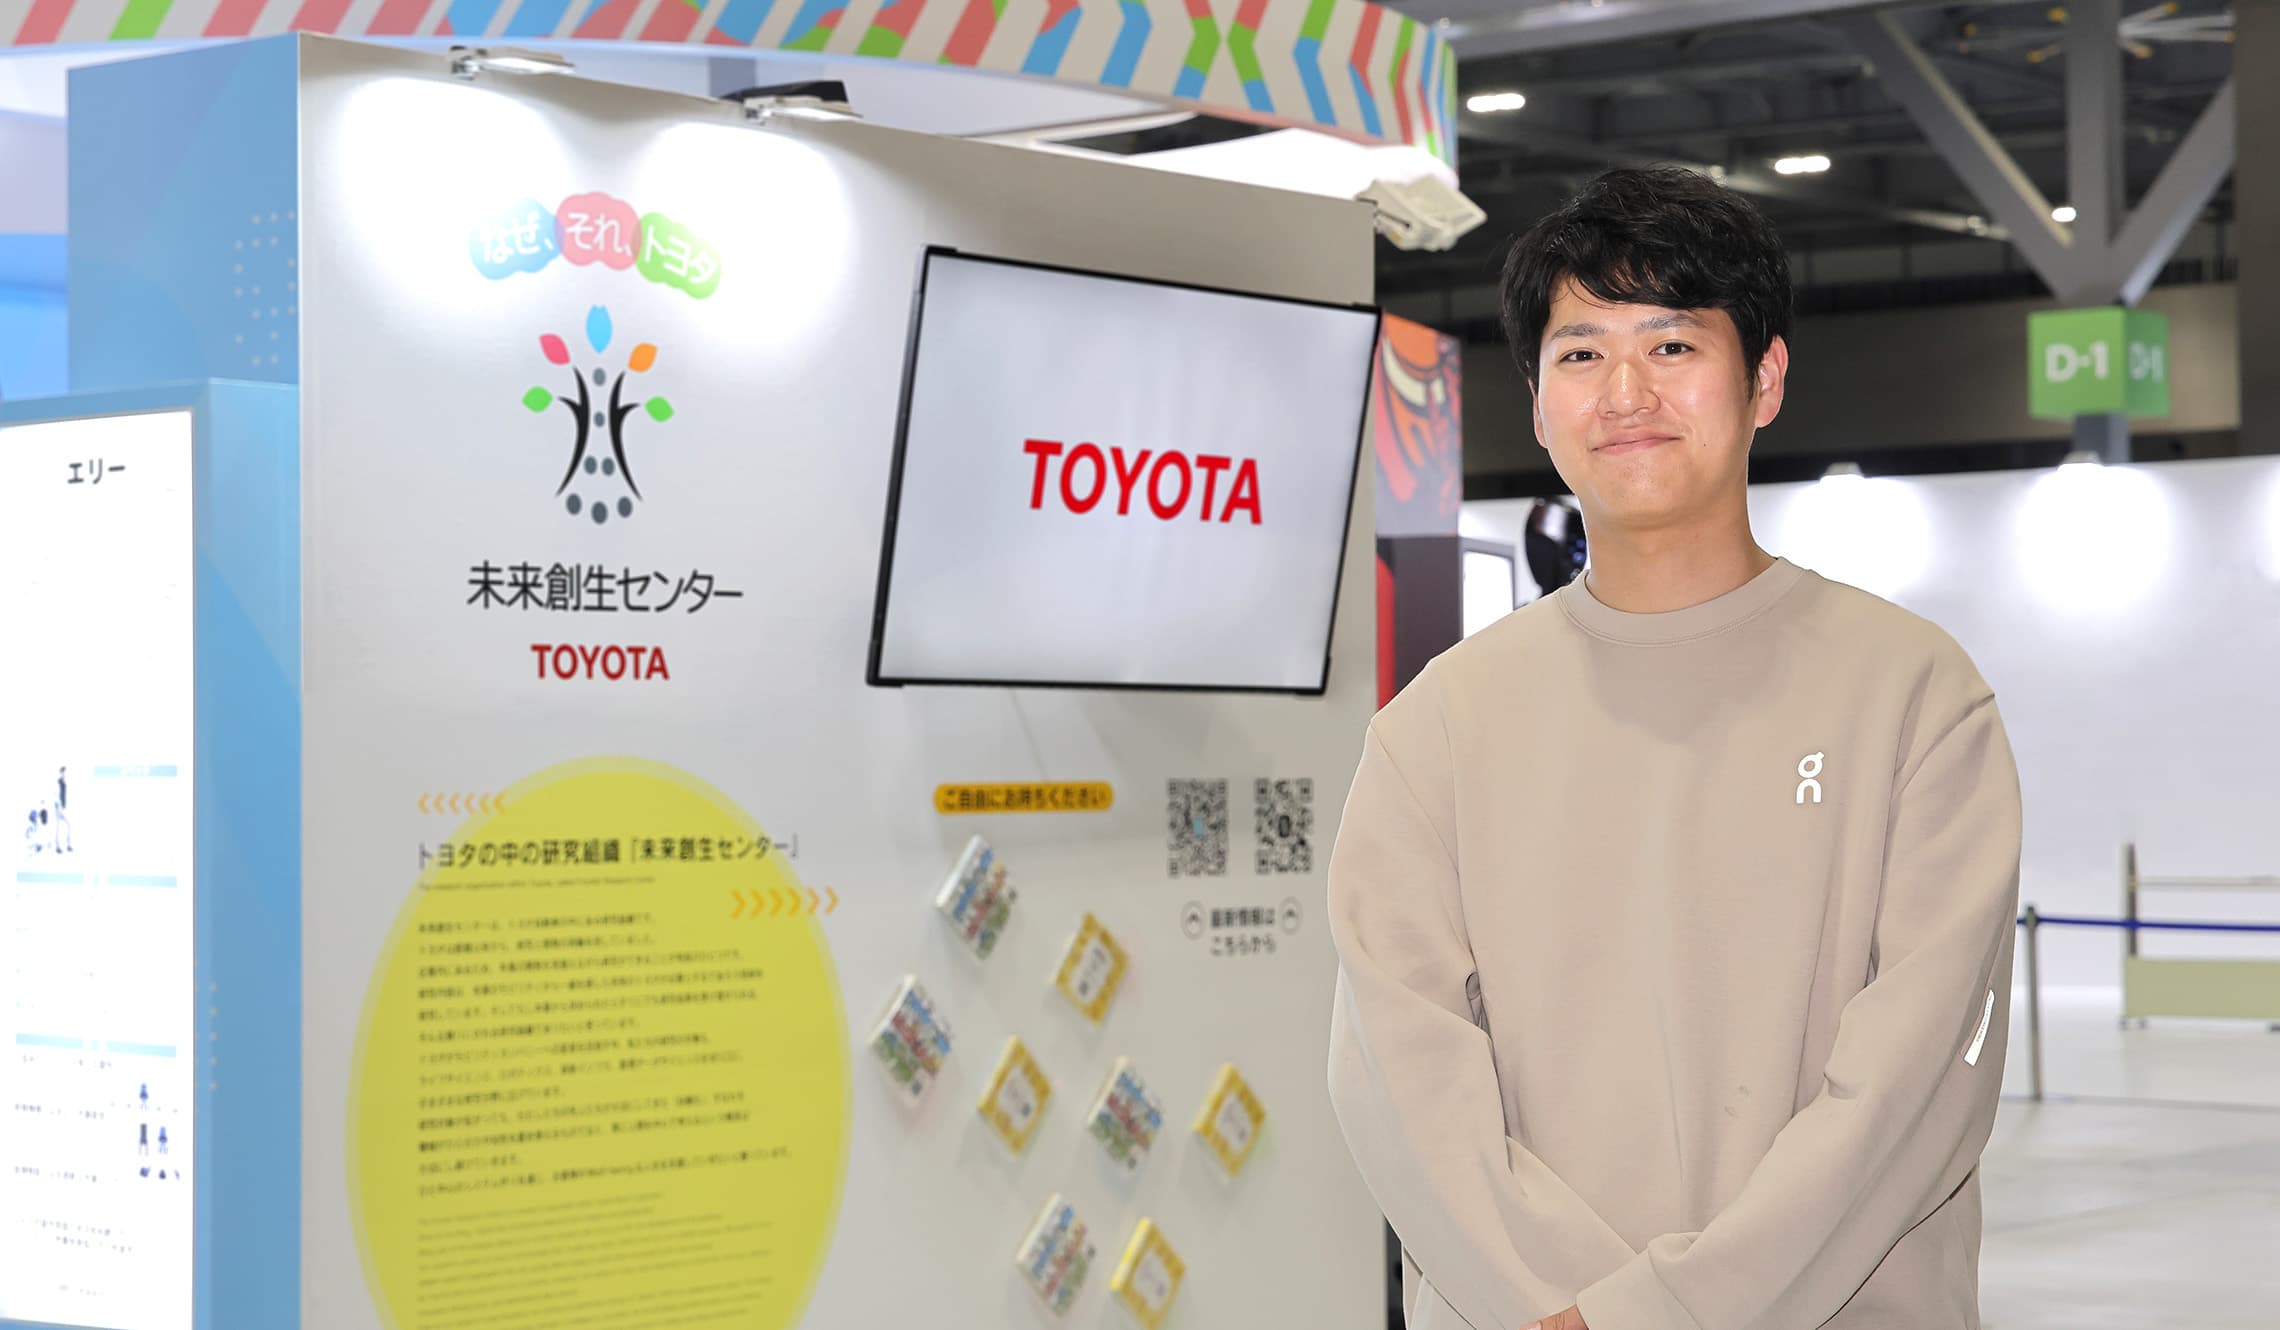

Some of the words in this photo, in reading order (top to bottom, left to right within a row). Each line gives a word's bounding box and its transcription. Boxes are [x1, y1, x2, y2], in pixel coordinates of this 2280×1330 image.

[2044, 340, 2110, 383] D-1
[67, 458, 126, 485] エリー
[1023, 438, 1262, 525] TOYOTA
[466, 559, 743, 613] 未来創生センター
[530, 643, 670, 681] TOYOTA
[943, 786, 1107, 812] ご自由にお持ちください
[1211, 907, 1275, 929] 最新情報は
[1210, 932, 1276, 957] こちらから
